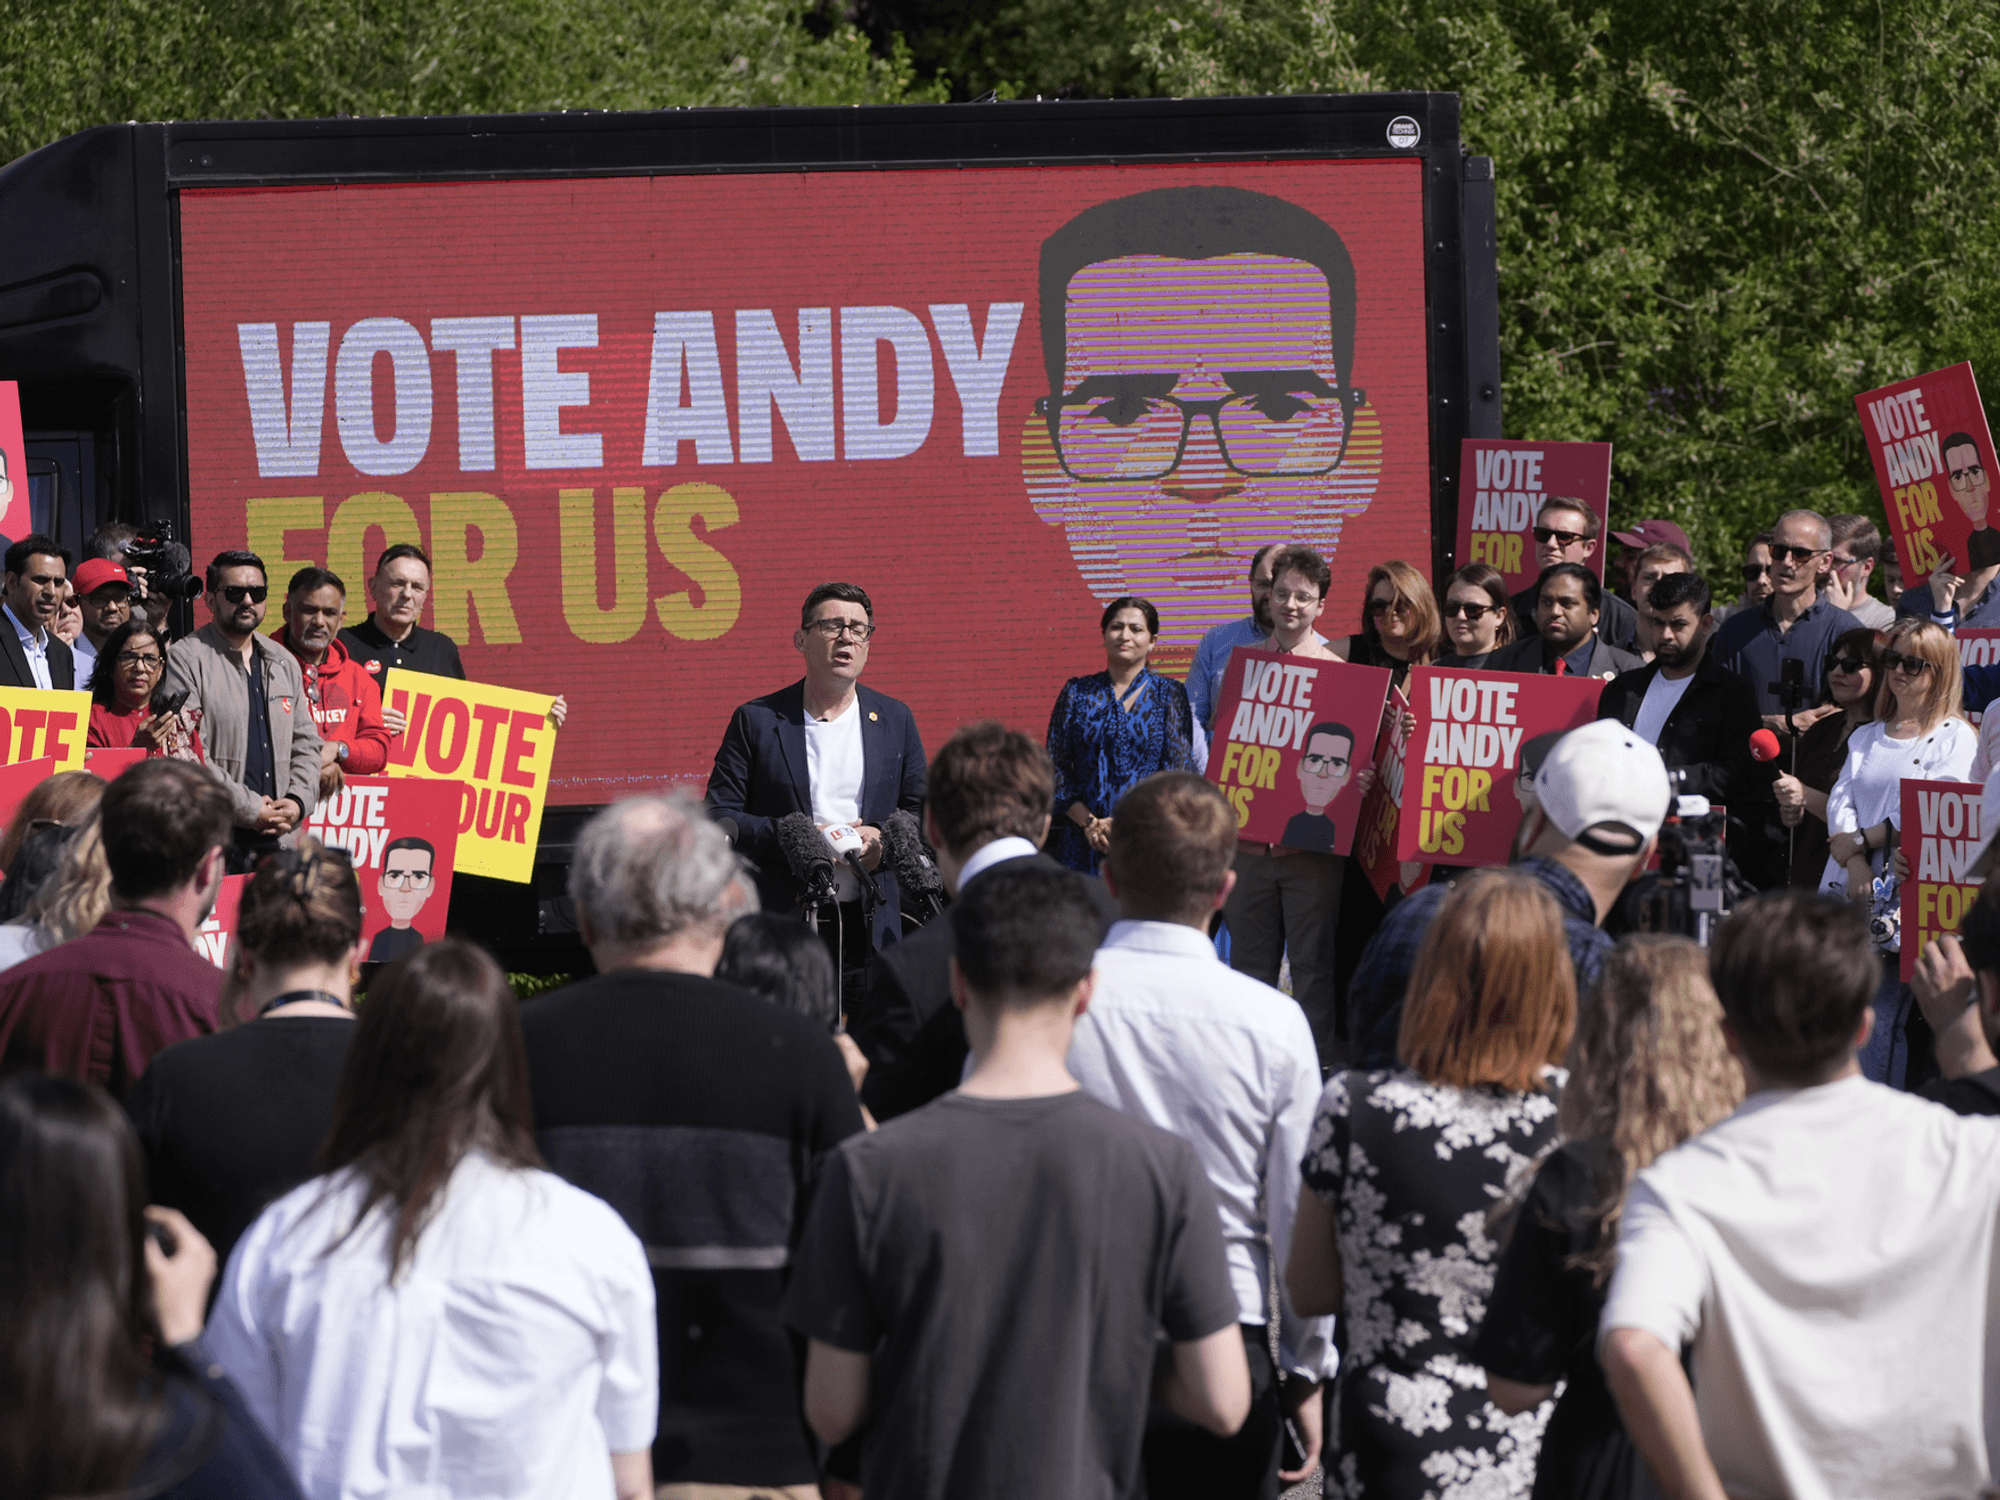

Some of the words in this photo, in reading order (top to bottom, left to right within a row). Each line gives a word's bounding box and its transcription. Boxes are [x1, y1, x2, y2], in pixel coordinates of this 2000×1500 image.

[237, 313, 604, 477] VOTE
[641, 302, 1025, 466] ANDY
[1868, 388, 1931, 443] VOTE
[1476, 449, 1544, 490] VOTE
[1883, 430, 1944, 488] ANDY
[1471, 491, 1548, 532] ANDY
[1893, 481, 1944, 531] FOR
[246, 491, 523, 645] FOR
[558, 481, 742, 645] US
[1470, 533, 1524, 573] FOR
[1905, 528, 1940, 575] US
[1241, 658, 1318, 708] VOTE
[1430, 677, 1519, 724] VOTE
[387, 688, 545, 788] VOTE
[1228, 700, 1315, 750] ANDY
[1424, 721, 1524, 769] ANDY
[1220, 742, 1281, 790] FOR
[1422, 765, 1492, 812] FOR
[309, 785, 389, 827] VOTE
[1917, 790, 1983, 839] VOT
[1418, 809, 1466, 855] US
[1917, 836, 1986, 885] AN
